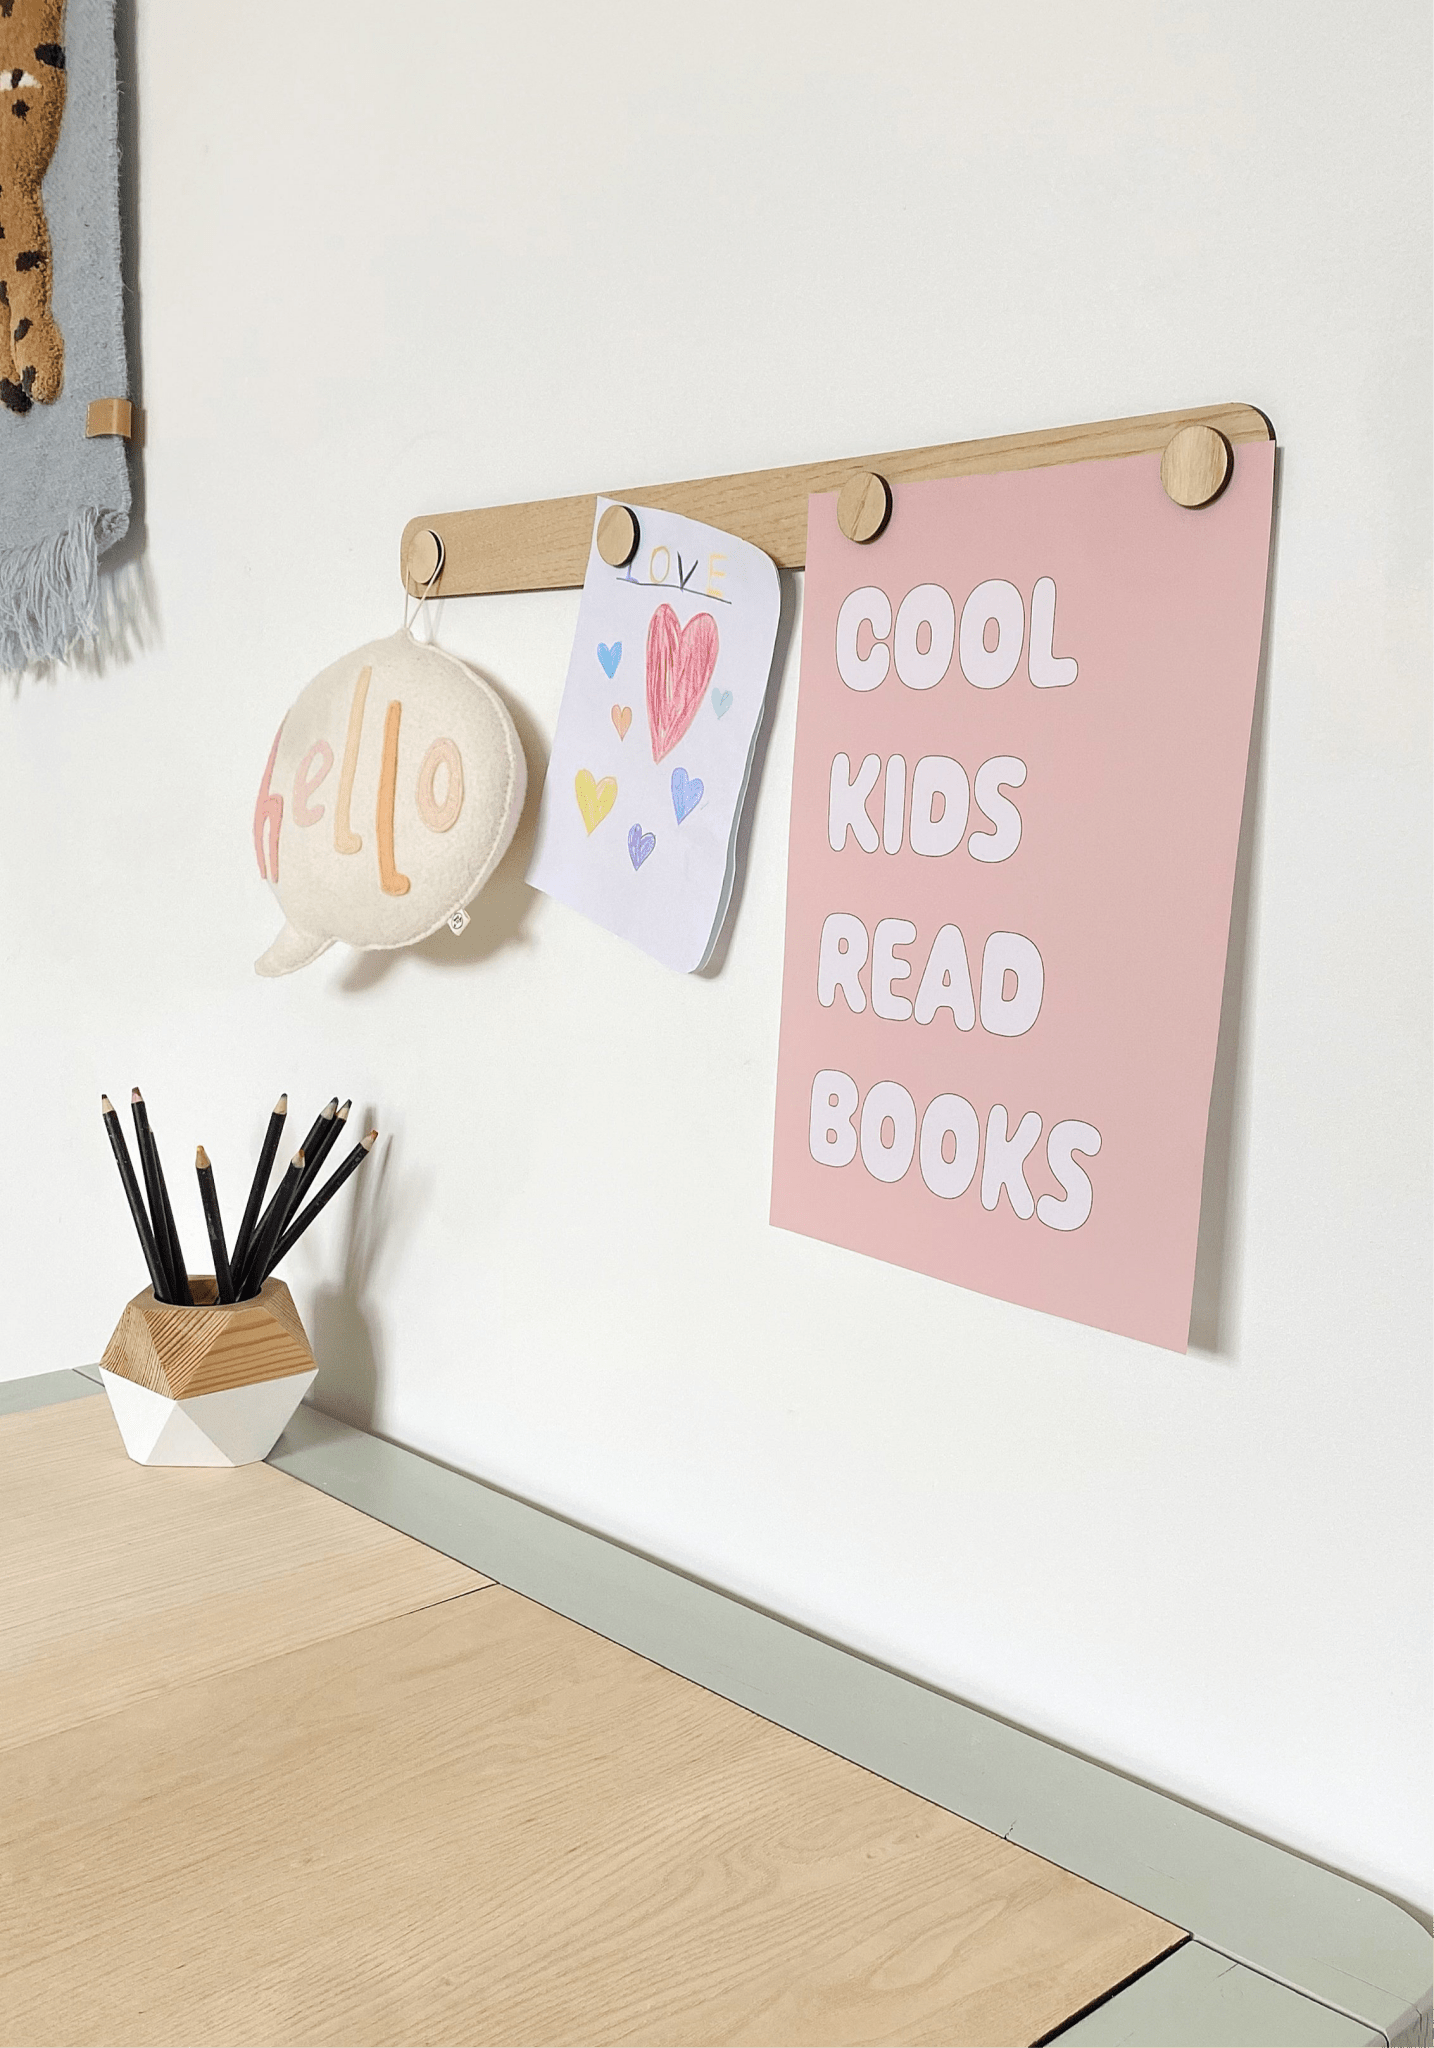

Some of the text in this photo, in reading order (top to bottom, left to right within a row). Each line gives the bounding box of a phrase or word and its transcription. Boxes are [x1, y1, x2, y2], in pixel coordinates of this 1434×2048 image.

[835, 576, 1079, 692] COOL
[252, 665, 464, 896] hello
[827, 752, 1028, 864] KIDS
[817, 912, 1046, 1038] READ
[808, 1069, 1103, 1232] BOOKS
